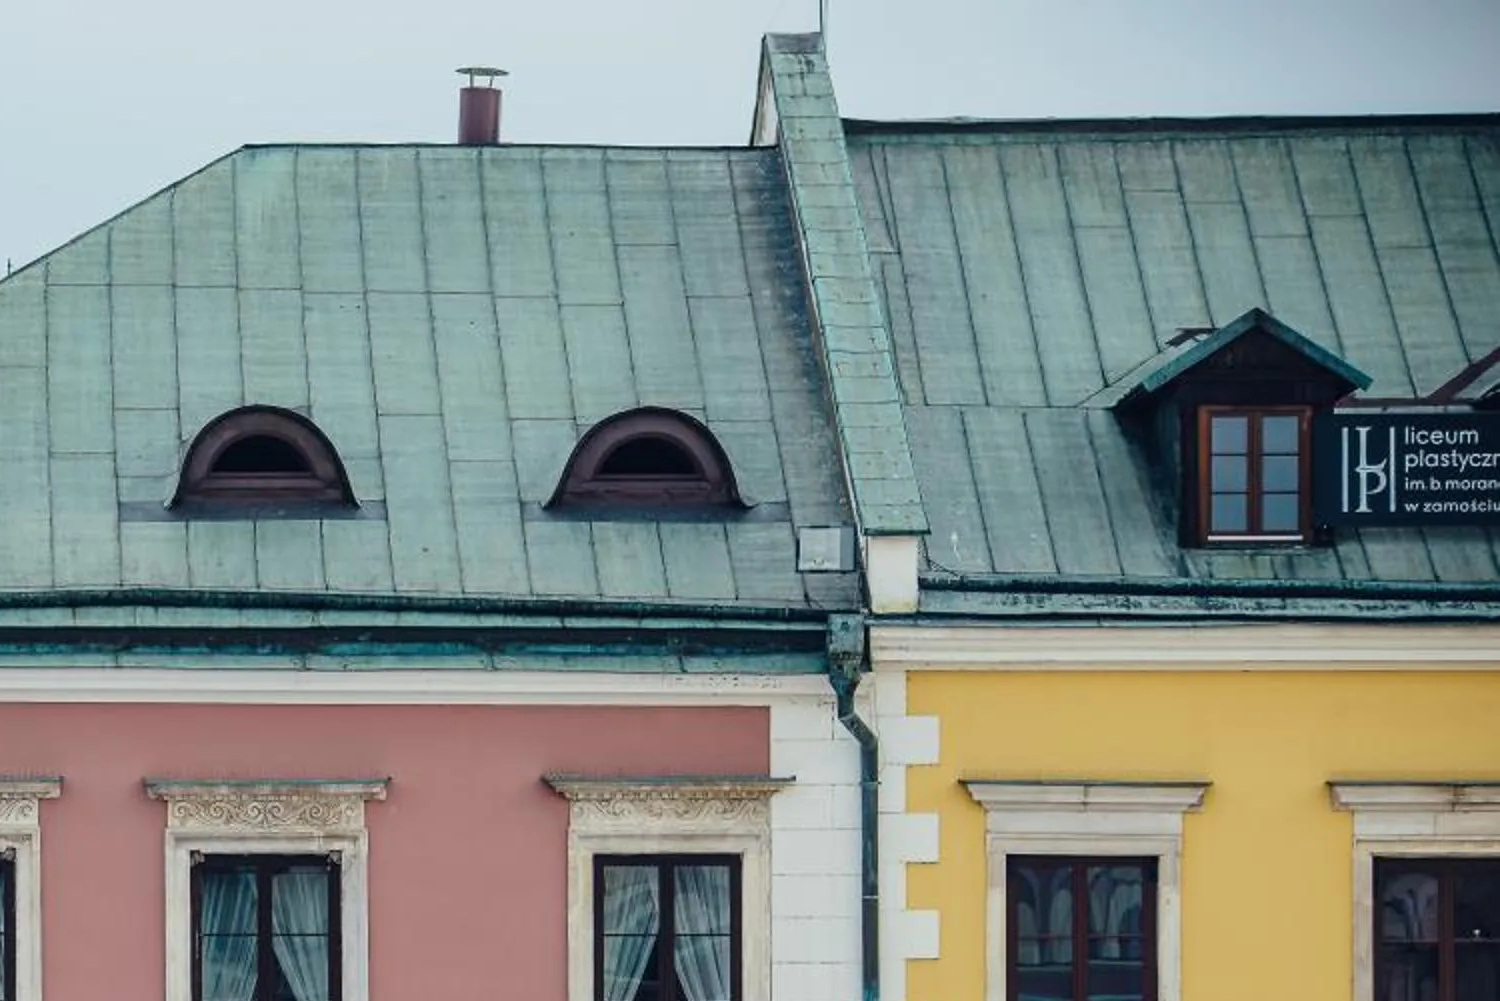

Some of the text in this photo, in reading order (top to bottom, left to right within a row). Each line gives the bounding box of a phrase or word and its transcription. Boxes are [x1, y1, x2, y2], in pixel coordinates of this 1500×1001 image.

[1405, 426, 1479, 444] liceum
[1445, 479, 1500, 491] moran
[1404, 503, 1419, 512] w
